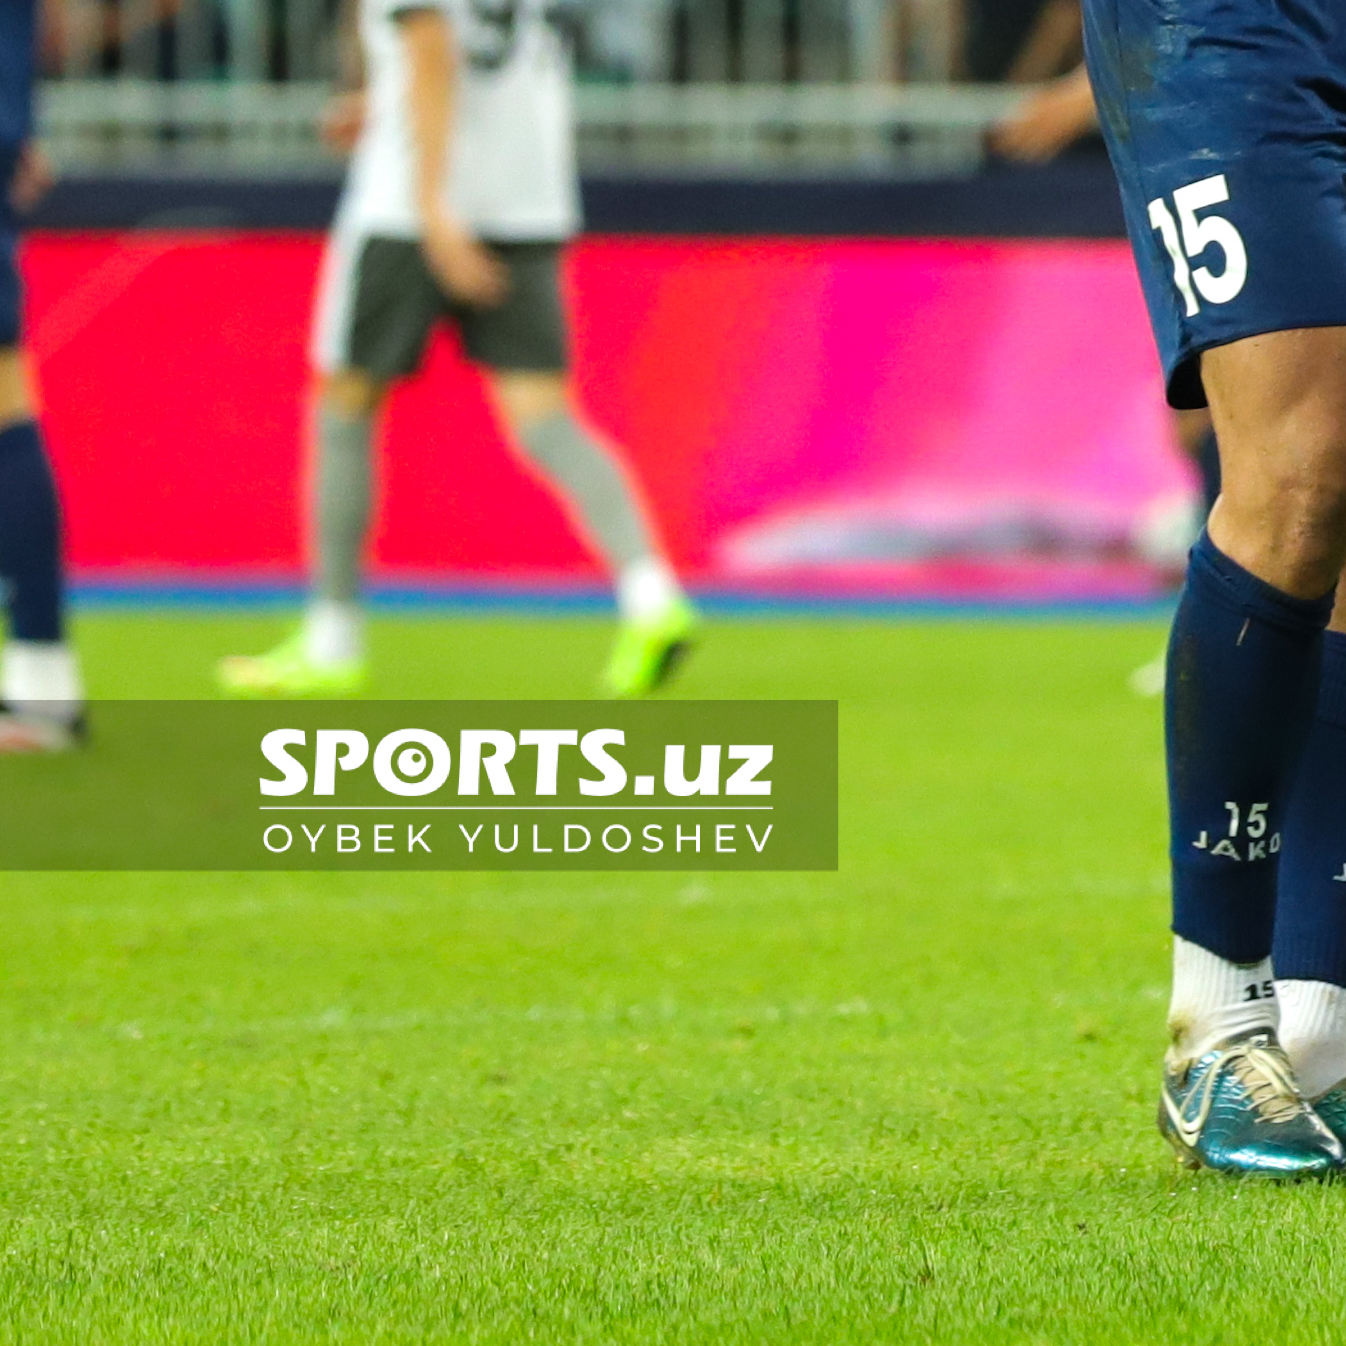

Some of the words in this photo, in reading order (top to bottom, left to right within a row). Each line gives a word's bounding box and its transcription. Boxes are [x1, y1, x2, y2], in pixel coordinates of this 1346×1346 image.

[1147, 173, 1248, 318] 15
[1224, 801, 1269, 839] 15
[1191, 829, 1281, 862] JAKO
